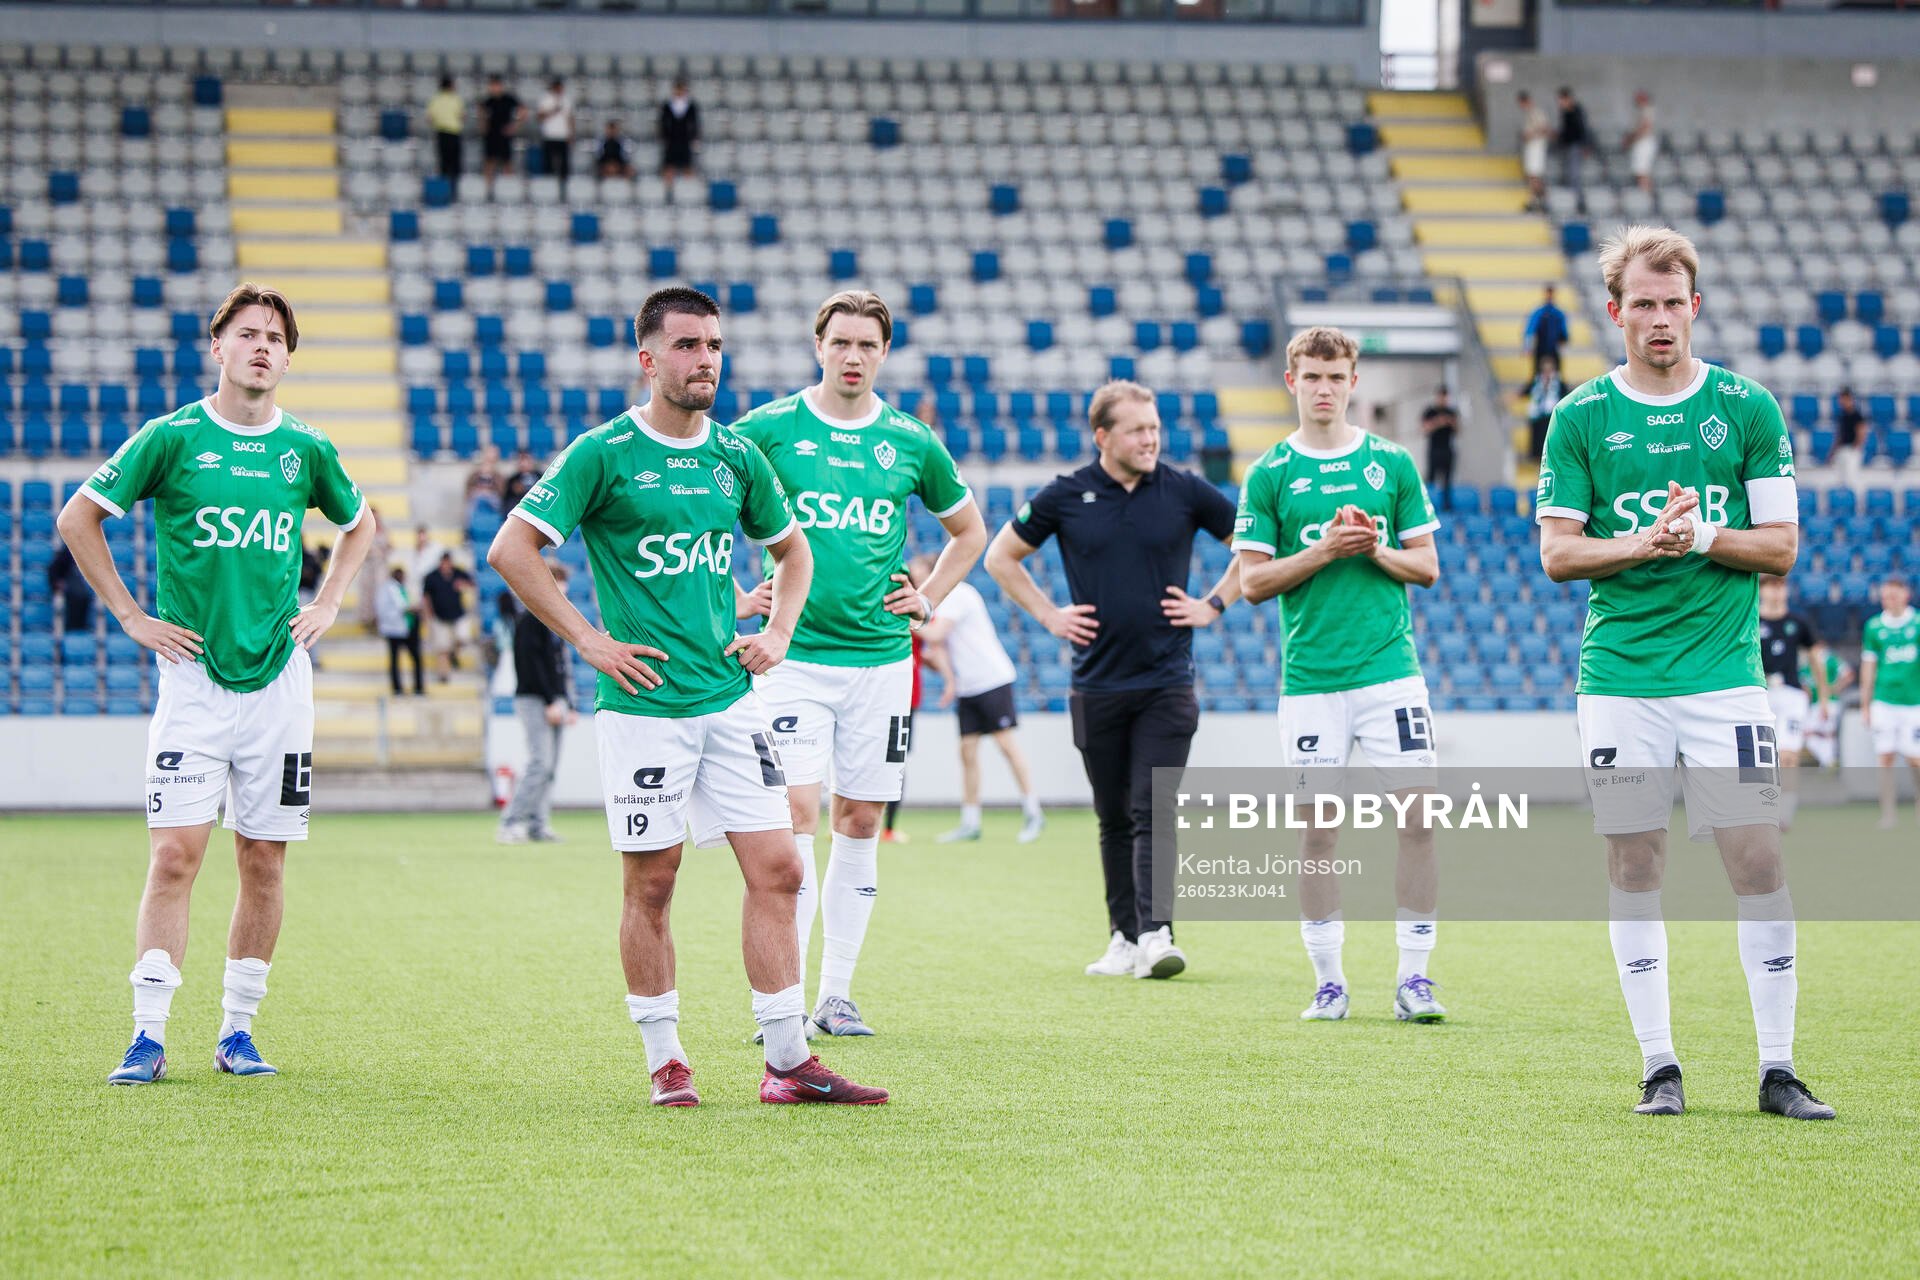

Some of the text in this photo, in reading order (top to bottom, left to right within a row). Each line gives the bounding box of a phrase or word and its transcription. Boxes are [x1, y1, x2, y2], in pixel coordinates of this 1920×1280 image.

[1609, 443, 1633, 451] umbro
[797, 491, 895, 535] SSAB
[193, 506, 294, 552] SSAB
[635, 531, 734, 578] SSAB
[174, 773, 206, 785] Energi
[1611, 772, 1645, 785] Energi
[613, 794, 656, 806] Borlänge
[625, 813, 649, 837] 19
